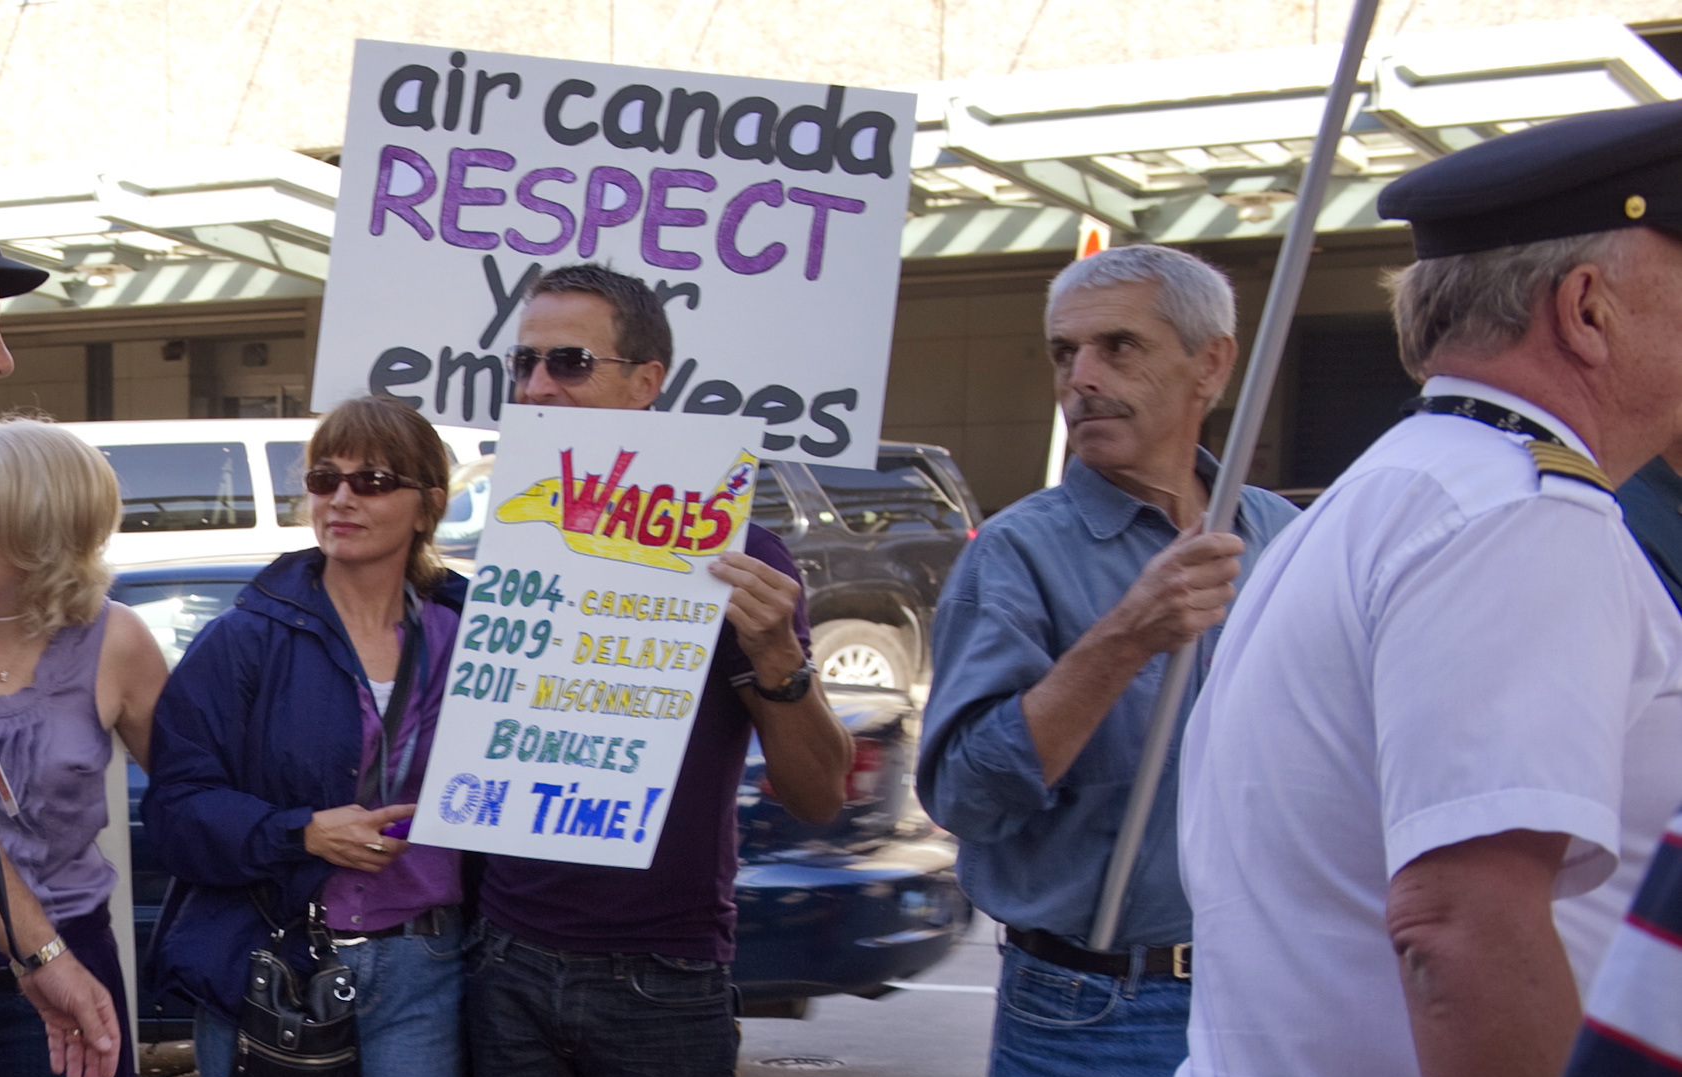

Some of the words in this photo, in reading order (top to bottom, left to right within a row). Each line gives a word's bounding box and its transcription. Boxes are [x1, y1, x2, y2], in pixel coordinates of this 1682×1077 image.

[379, 51, 522, 134] air
[544, 84, 896, 179] canada
[370, 144, 866, 282] RESPECT
[479, 254, 700, 350] yr
[370, 346, 858, 458] emees
[559, 448, 735, 550] WAGES
[579, 590, 720, 625] CANCELLED
[573, 632, 707, 671] DELAYED
[530, 675, 694, 720] MISCONNECTED
[485, 719, 647, 773] BONUSES
[438, 773, 510, 826] ON
